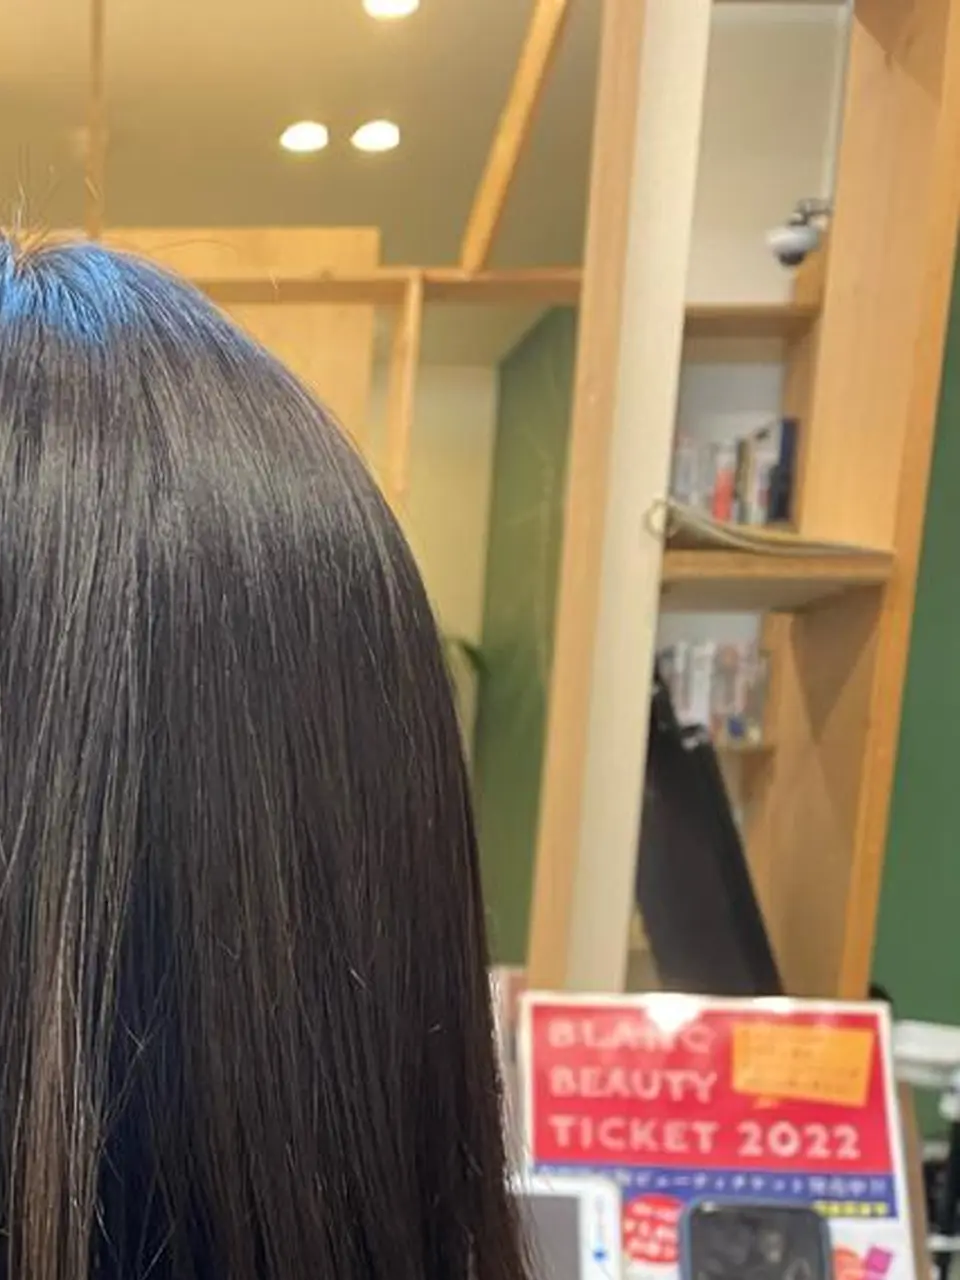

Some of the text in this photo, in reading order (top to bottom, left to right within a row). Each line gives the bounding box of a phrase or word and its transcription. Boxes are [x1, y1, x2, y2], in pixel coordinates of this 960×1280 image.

[550, 1065, 718, 1104] BEAUTY
[548, 1114, 862, 1160] TICKET 2022
